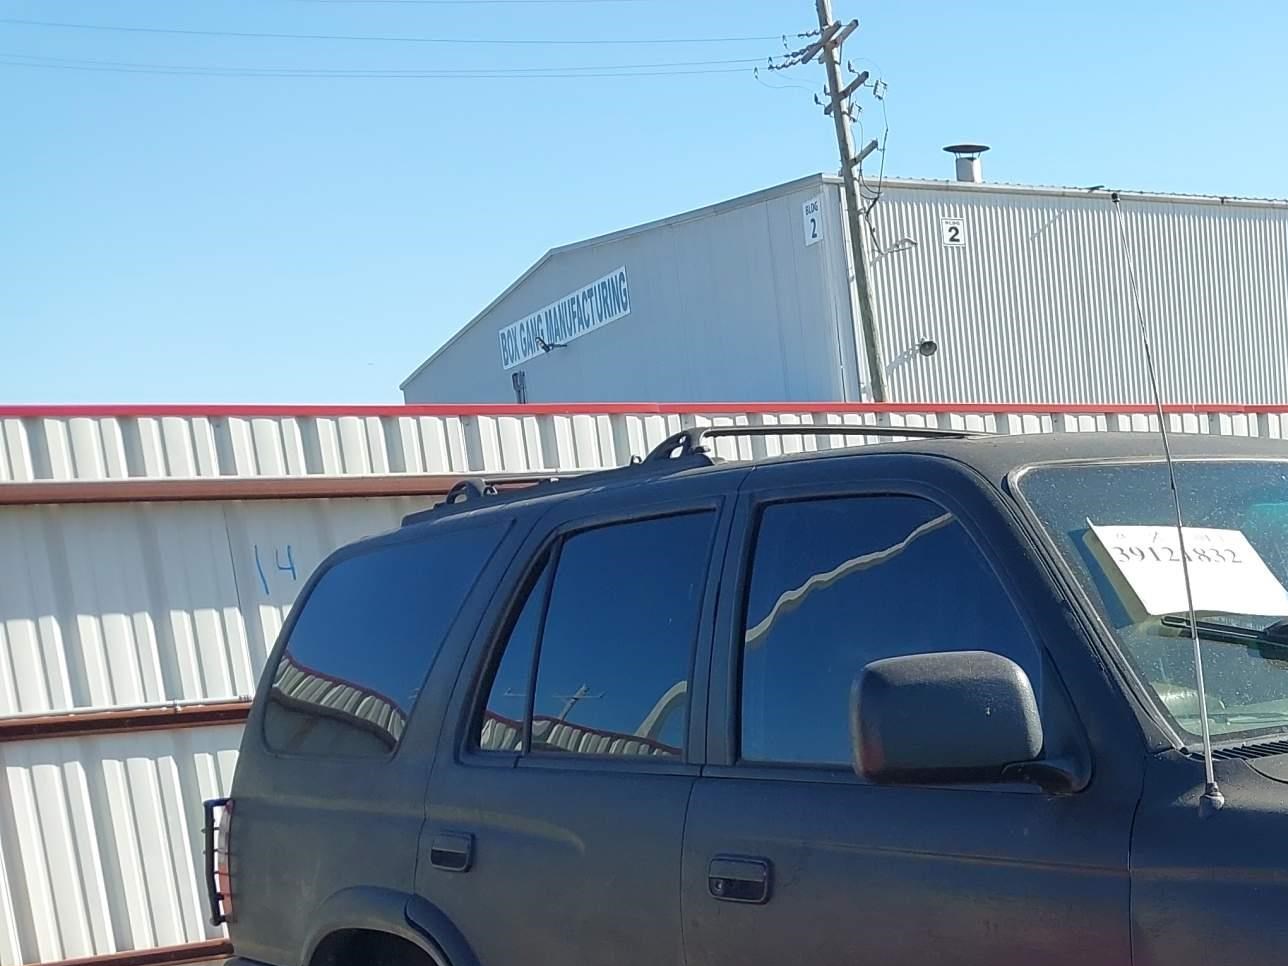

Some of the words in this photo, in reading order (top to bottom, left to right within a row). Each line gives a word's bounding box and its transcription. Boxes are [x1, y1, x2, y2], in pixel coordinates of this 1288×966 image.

[805, 200, 819, 216] BLDG
[810, 218, 818, 239] 2
[948, 226, 960, 242] 2
[500, 326, 521, 367] BOX
[544, 271, 628, 345] MANUFACTURING
[253, 543, 298, 596] 14
